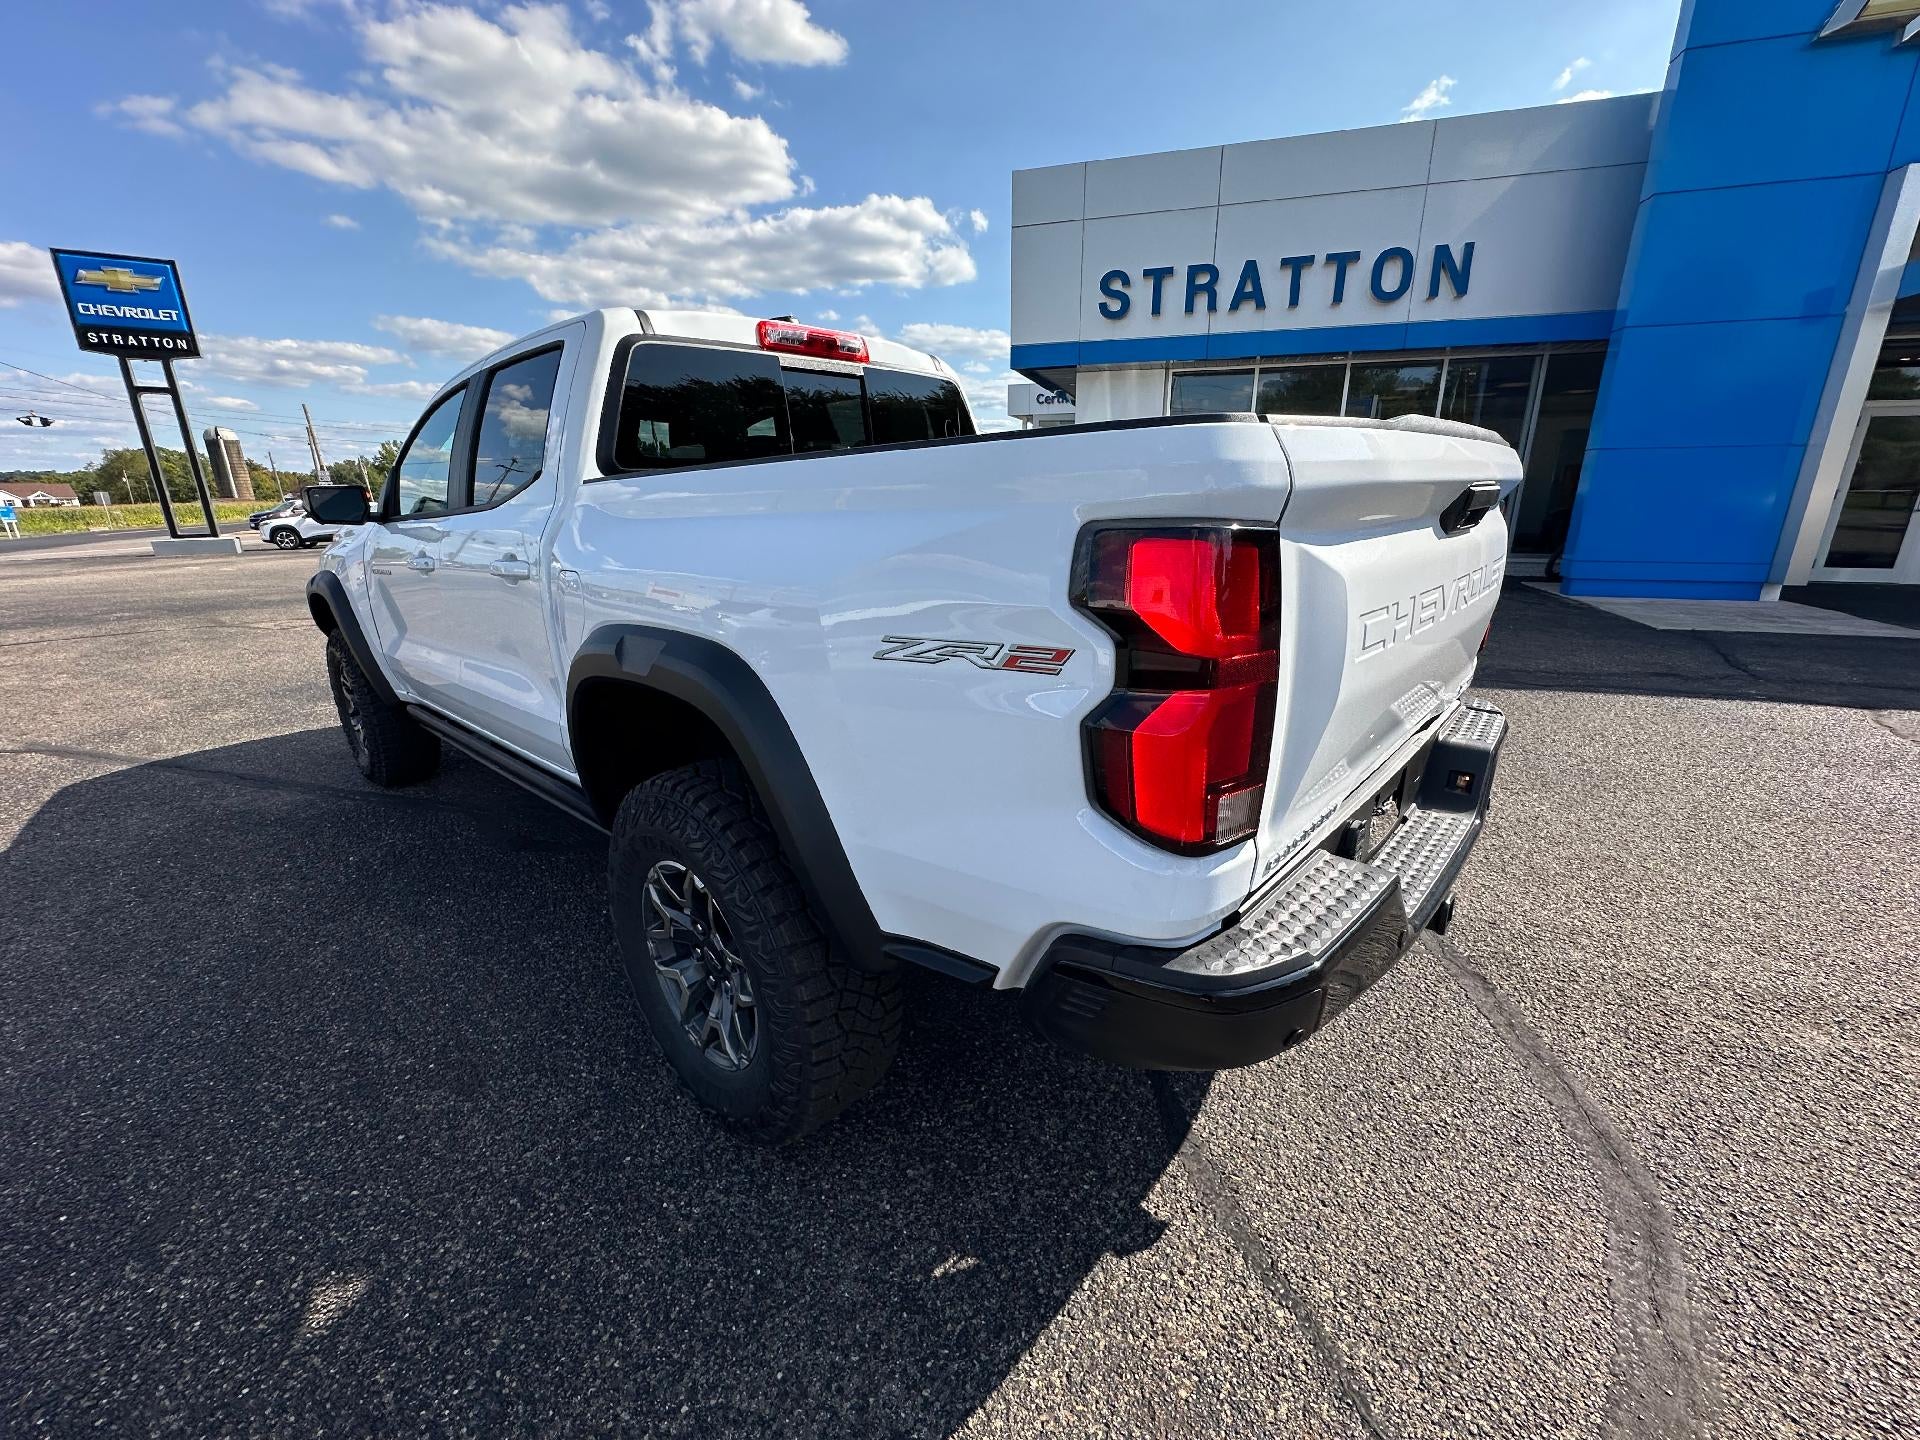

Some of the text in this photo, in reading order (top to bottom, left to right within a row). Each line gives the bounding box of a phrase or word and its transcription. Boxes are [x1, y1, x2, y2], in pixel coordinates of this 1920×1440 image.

[1098, 241, 1476, 321] STRATTON
[77, 302, 179, 321] CHEVROLET
[87, 332, 188, 350] STRATTON
[1355, 555, 1506, 663] CHEVROLE
[872, 634, 1077, 676] ZR2
